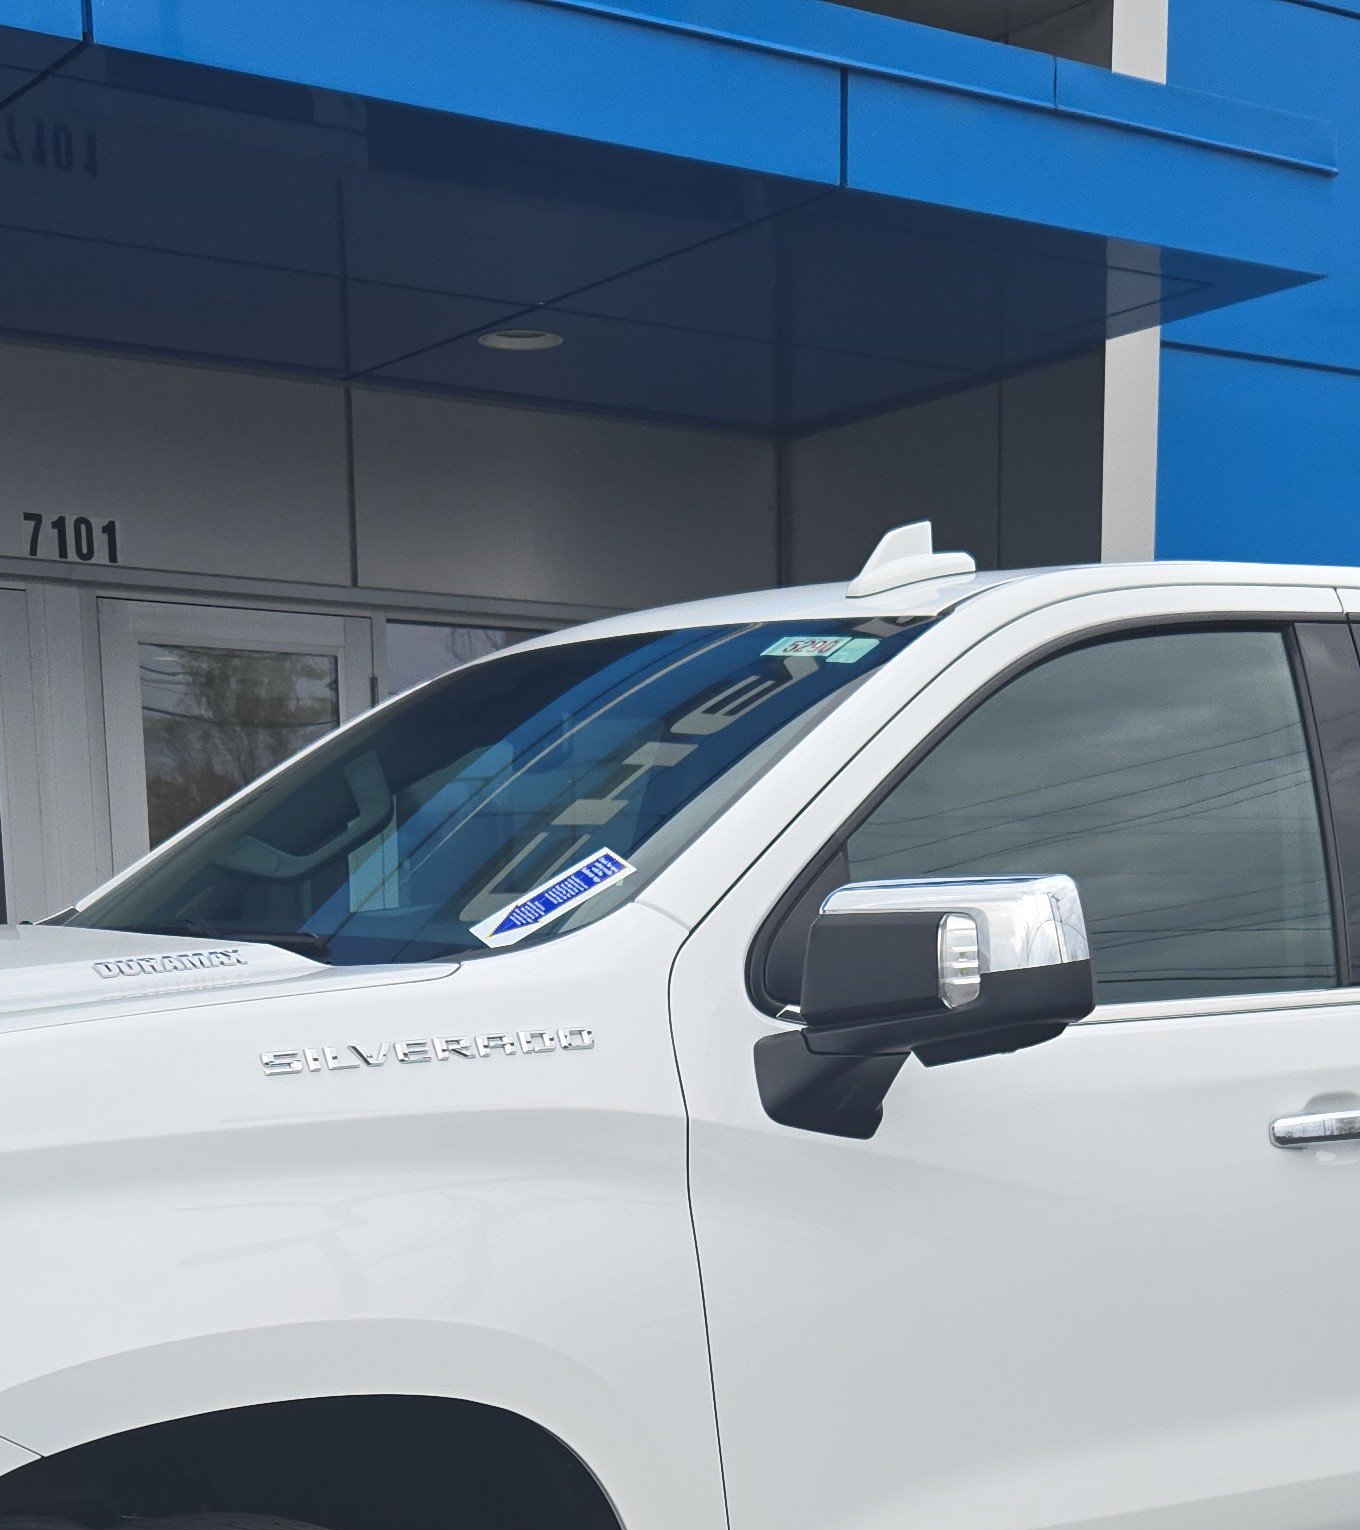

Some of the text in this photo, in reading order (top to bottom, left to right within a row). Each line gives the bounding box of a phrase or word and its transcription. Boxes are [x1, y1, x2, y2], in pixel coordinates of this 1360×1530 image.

[22, 511, 119, 564] 7101
[92, 949, 249, 980] DURAMAX
[259, 1025, 596, 1076] SILVERADO
